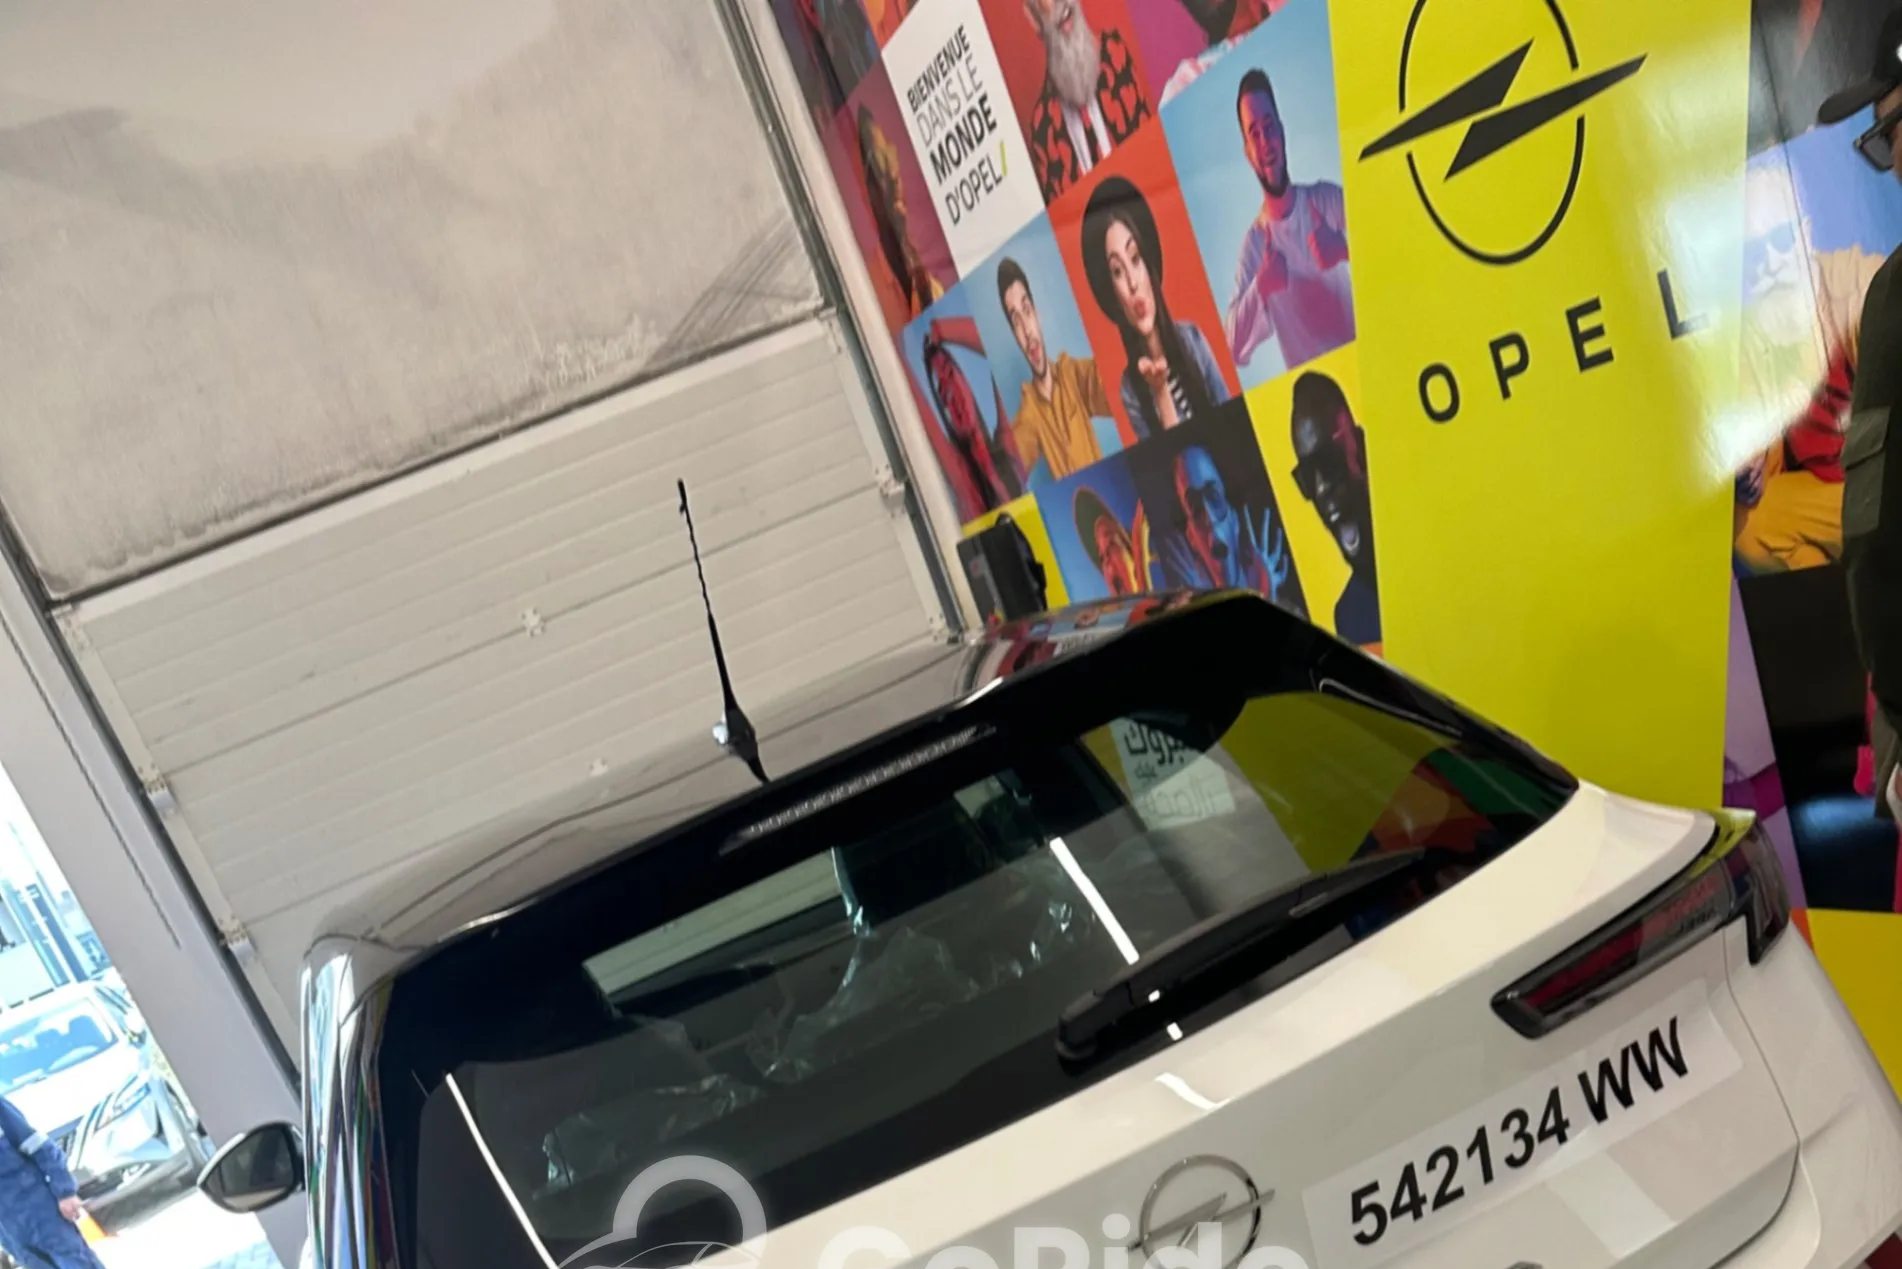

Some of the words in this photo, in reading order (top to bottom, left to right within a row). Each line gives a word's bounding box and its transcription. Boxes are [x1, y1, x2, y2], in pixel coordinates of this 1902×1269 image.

[907, 25, 970, 113] BIENVENUE
[916, 77, 961, 149] DANS
[957, 53, 983, 107] LE
[929, 90, 997, 186] MONDE
[1418, 268, 1711, 424] OPEL
[1123, 722, 1185, 765] بروك
[1351, 1085, 1570, 1246] 542134
[1578, 1016, 1689, 1123] WW
